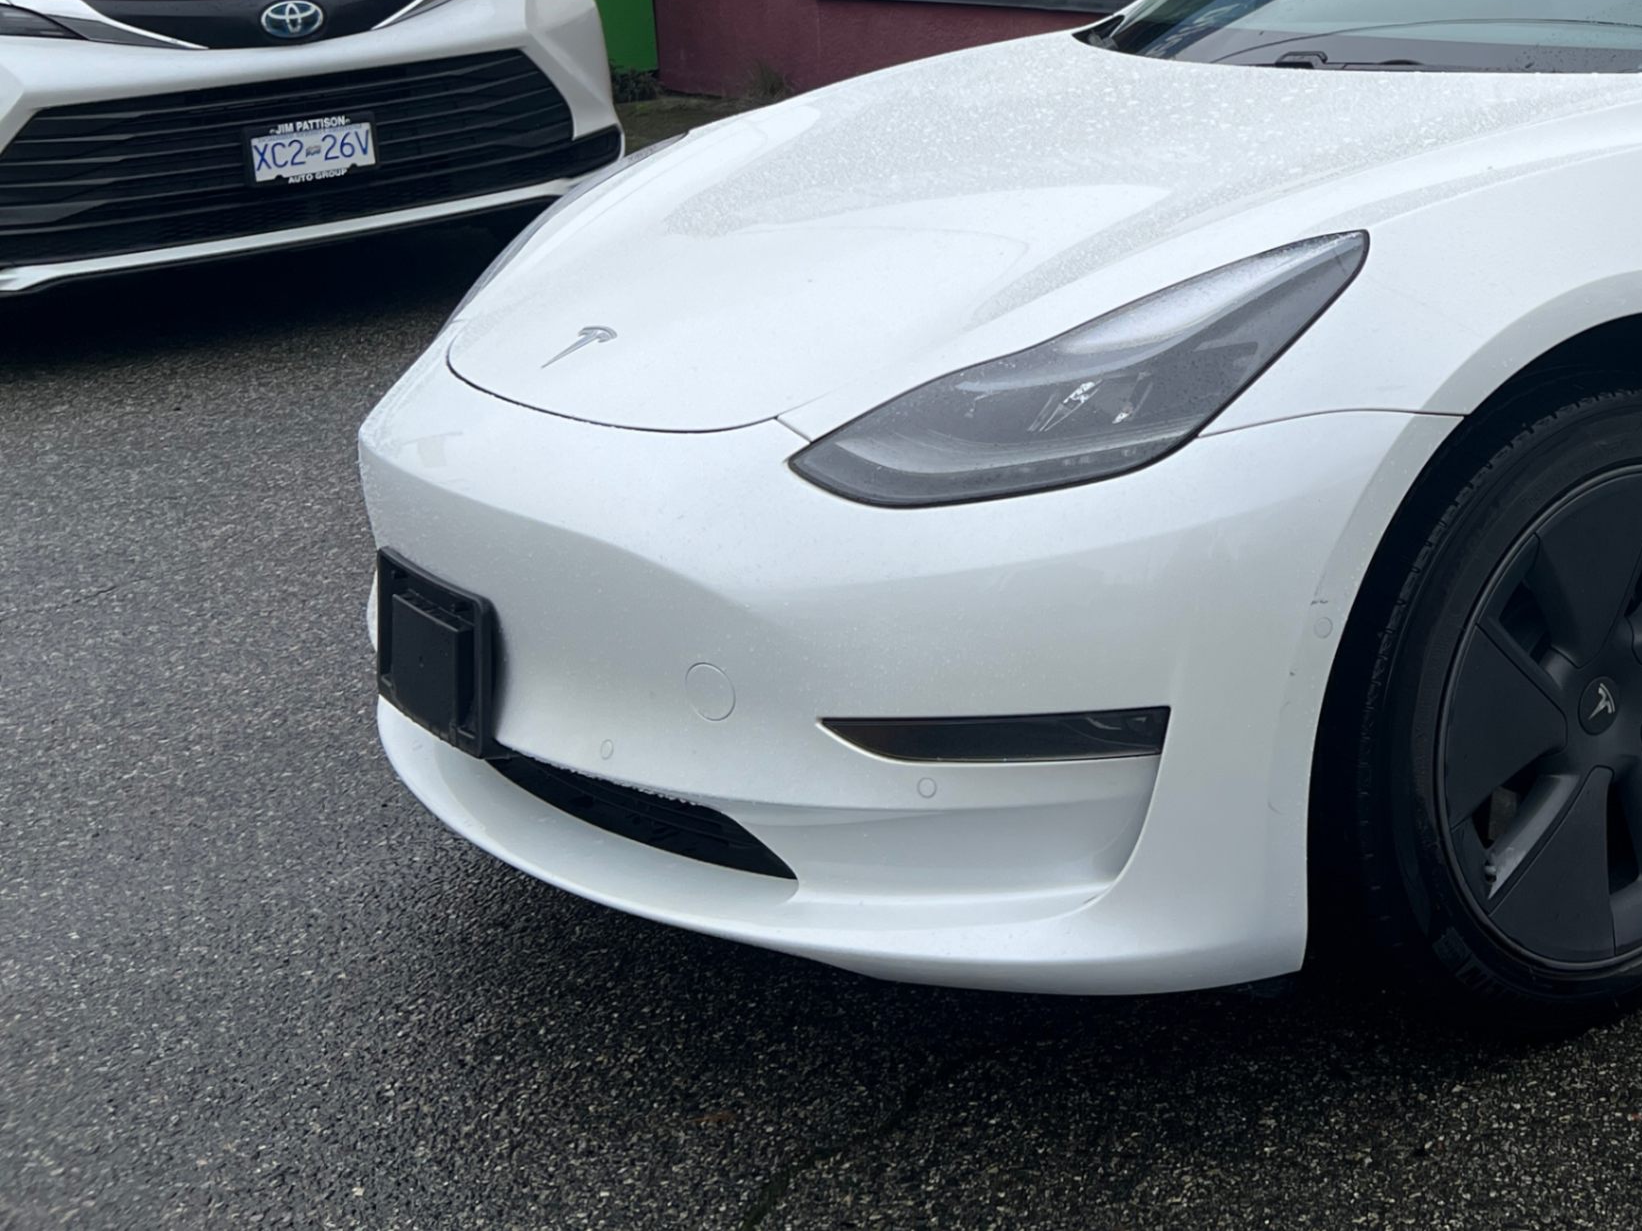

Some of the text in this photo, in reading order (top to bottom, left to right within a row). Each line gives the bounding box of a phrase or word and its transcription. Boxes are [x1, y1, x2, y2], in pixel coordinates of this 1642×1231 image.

[275, 122, 294, 135] JIM
[296, 115, 346, 132] PATTISON
[288, 168, 348, 185] AUTO GROUP
